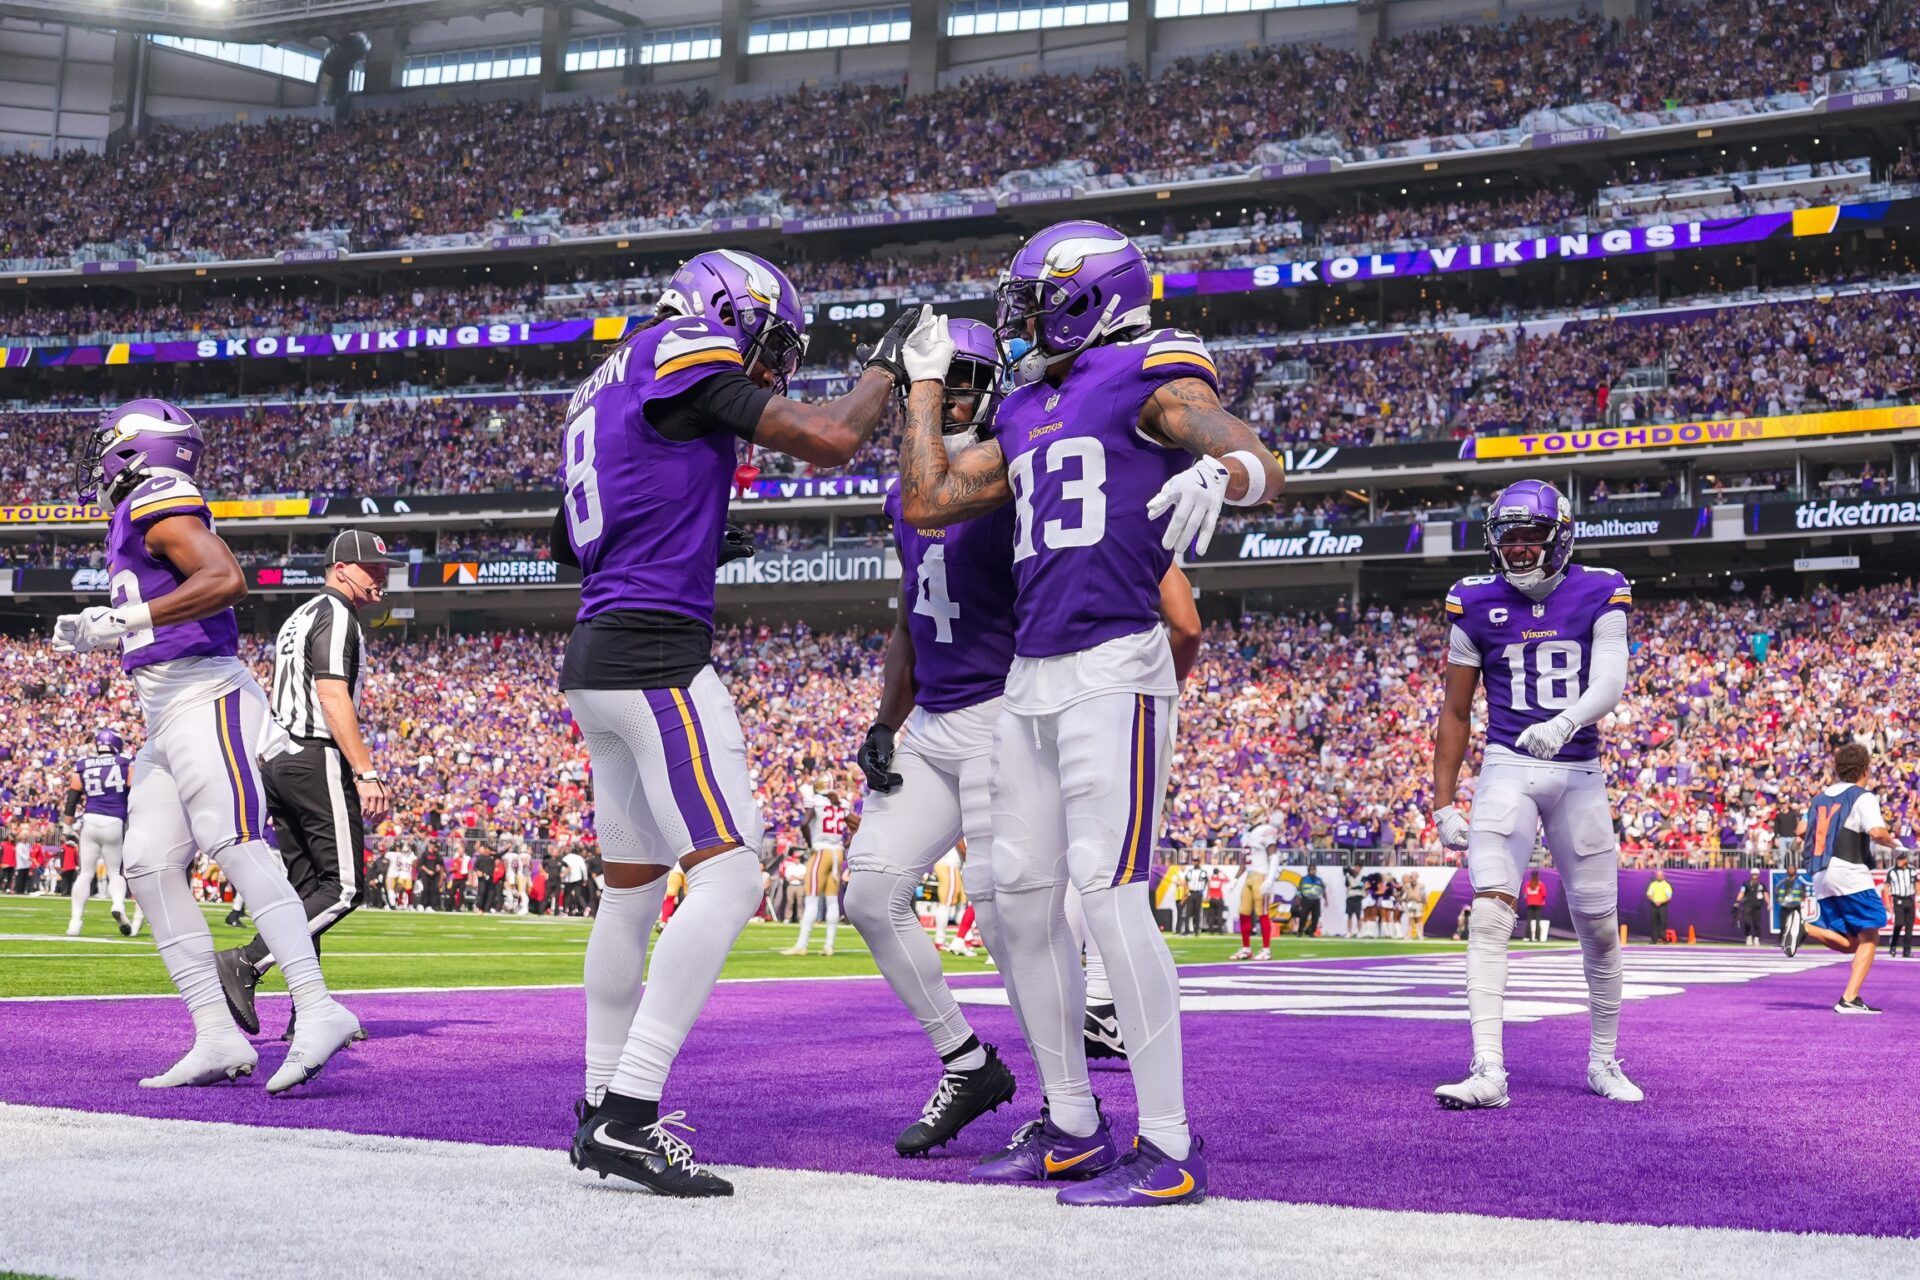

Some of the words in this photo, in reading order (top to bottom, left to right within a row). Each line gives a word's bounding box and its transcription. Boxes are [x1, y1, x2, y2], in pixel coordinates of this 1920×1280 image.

[1852, 92, 1883, 106] BROWN
[1894, 87, 1908, 100] 30
[1593, 126, 1606, 139] 77
[803, 217, 848, 231] MINNESOTA
[852, 213, 885, 226] VIKINGS
[908, 209, 928, 221] RING
[933, 208, 941, 218] OF
[946, 205, 974, 217] HONOR
[1252, 254, 1396, 287] SKOL
[1429, 222, 1701, 270] VIKINGS!
[828, 302, 886, 321] 6:49
[196, 336, 306, 358] SKOL
[331, 322, 531, 352] VIKINGS!
[1519, 420, 1764, 453] TOUCHDOWN
[564, 405, 604, 548] 8
[2, 506, 115, 521] TOUCHD
[1575, 519, 1660, 538] Healthcare
[256, 568, 282, 585] 3M
[478, 560, 558, 577] ANDERSEN
[912, 543, 961, 644] 4
[1488, 607, 1509, 624] C
[1502, 639, 1582, 711] 18
[83, 764, 126, 797] 64
[822, 805, 846, 835] 22
